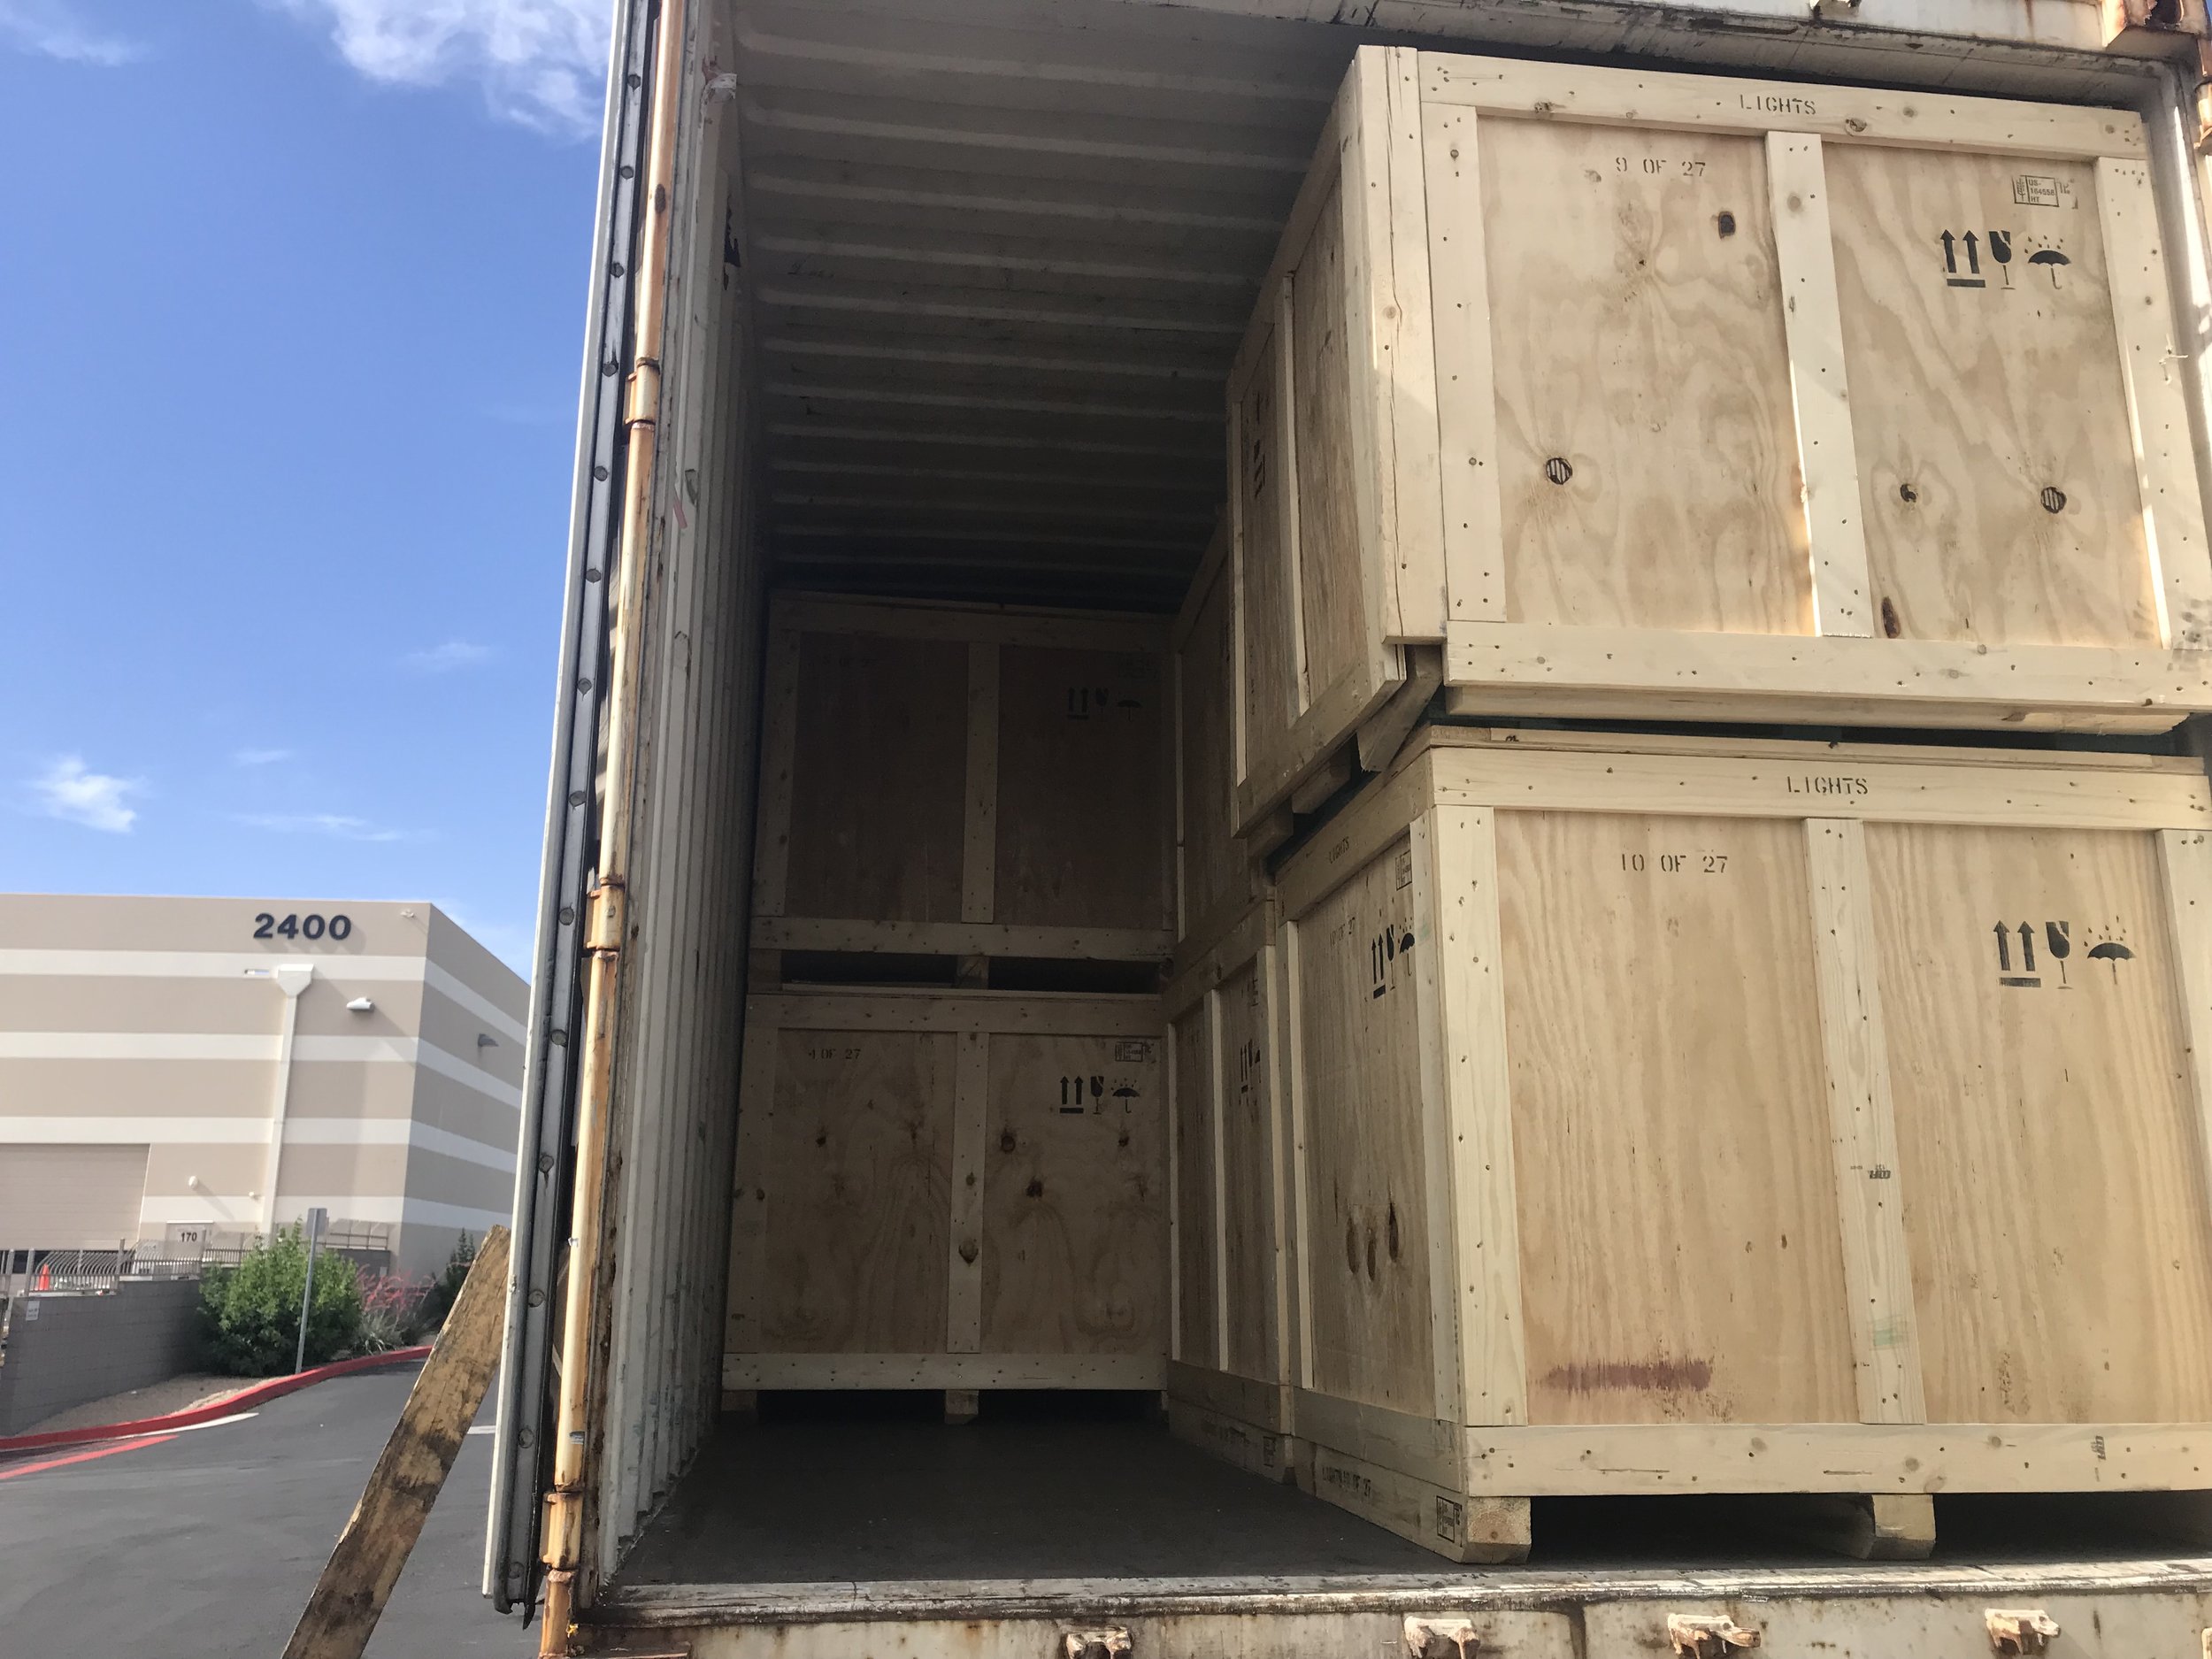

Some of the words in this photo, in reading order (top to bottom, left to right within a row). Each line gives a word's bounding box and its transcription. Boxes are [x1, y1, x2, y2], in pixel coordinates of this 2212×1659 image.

[1740, 94, 1816, 115] LIGHTS
[1616, 157, 1628, 173] 9
[1643, 158, 1667, 175] OF
[1681, 161, 1706, 177] 27
[1786, 776, 1869, 795] LIGHTS
[1622, 854, 1645, 872] 10
[1661, 855, 1686, 872] OF
[1702, 856, 1728, 873] 27
[253, 912, 352, 941] 2400
[845, 1048, 861, 1060] 27
[180, 1232, 197, 1242] 170
